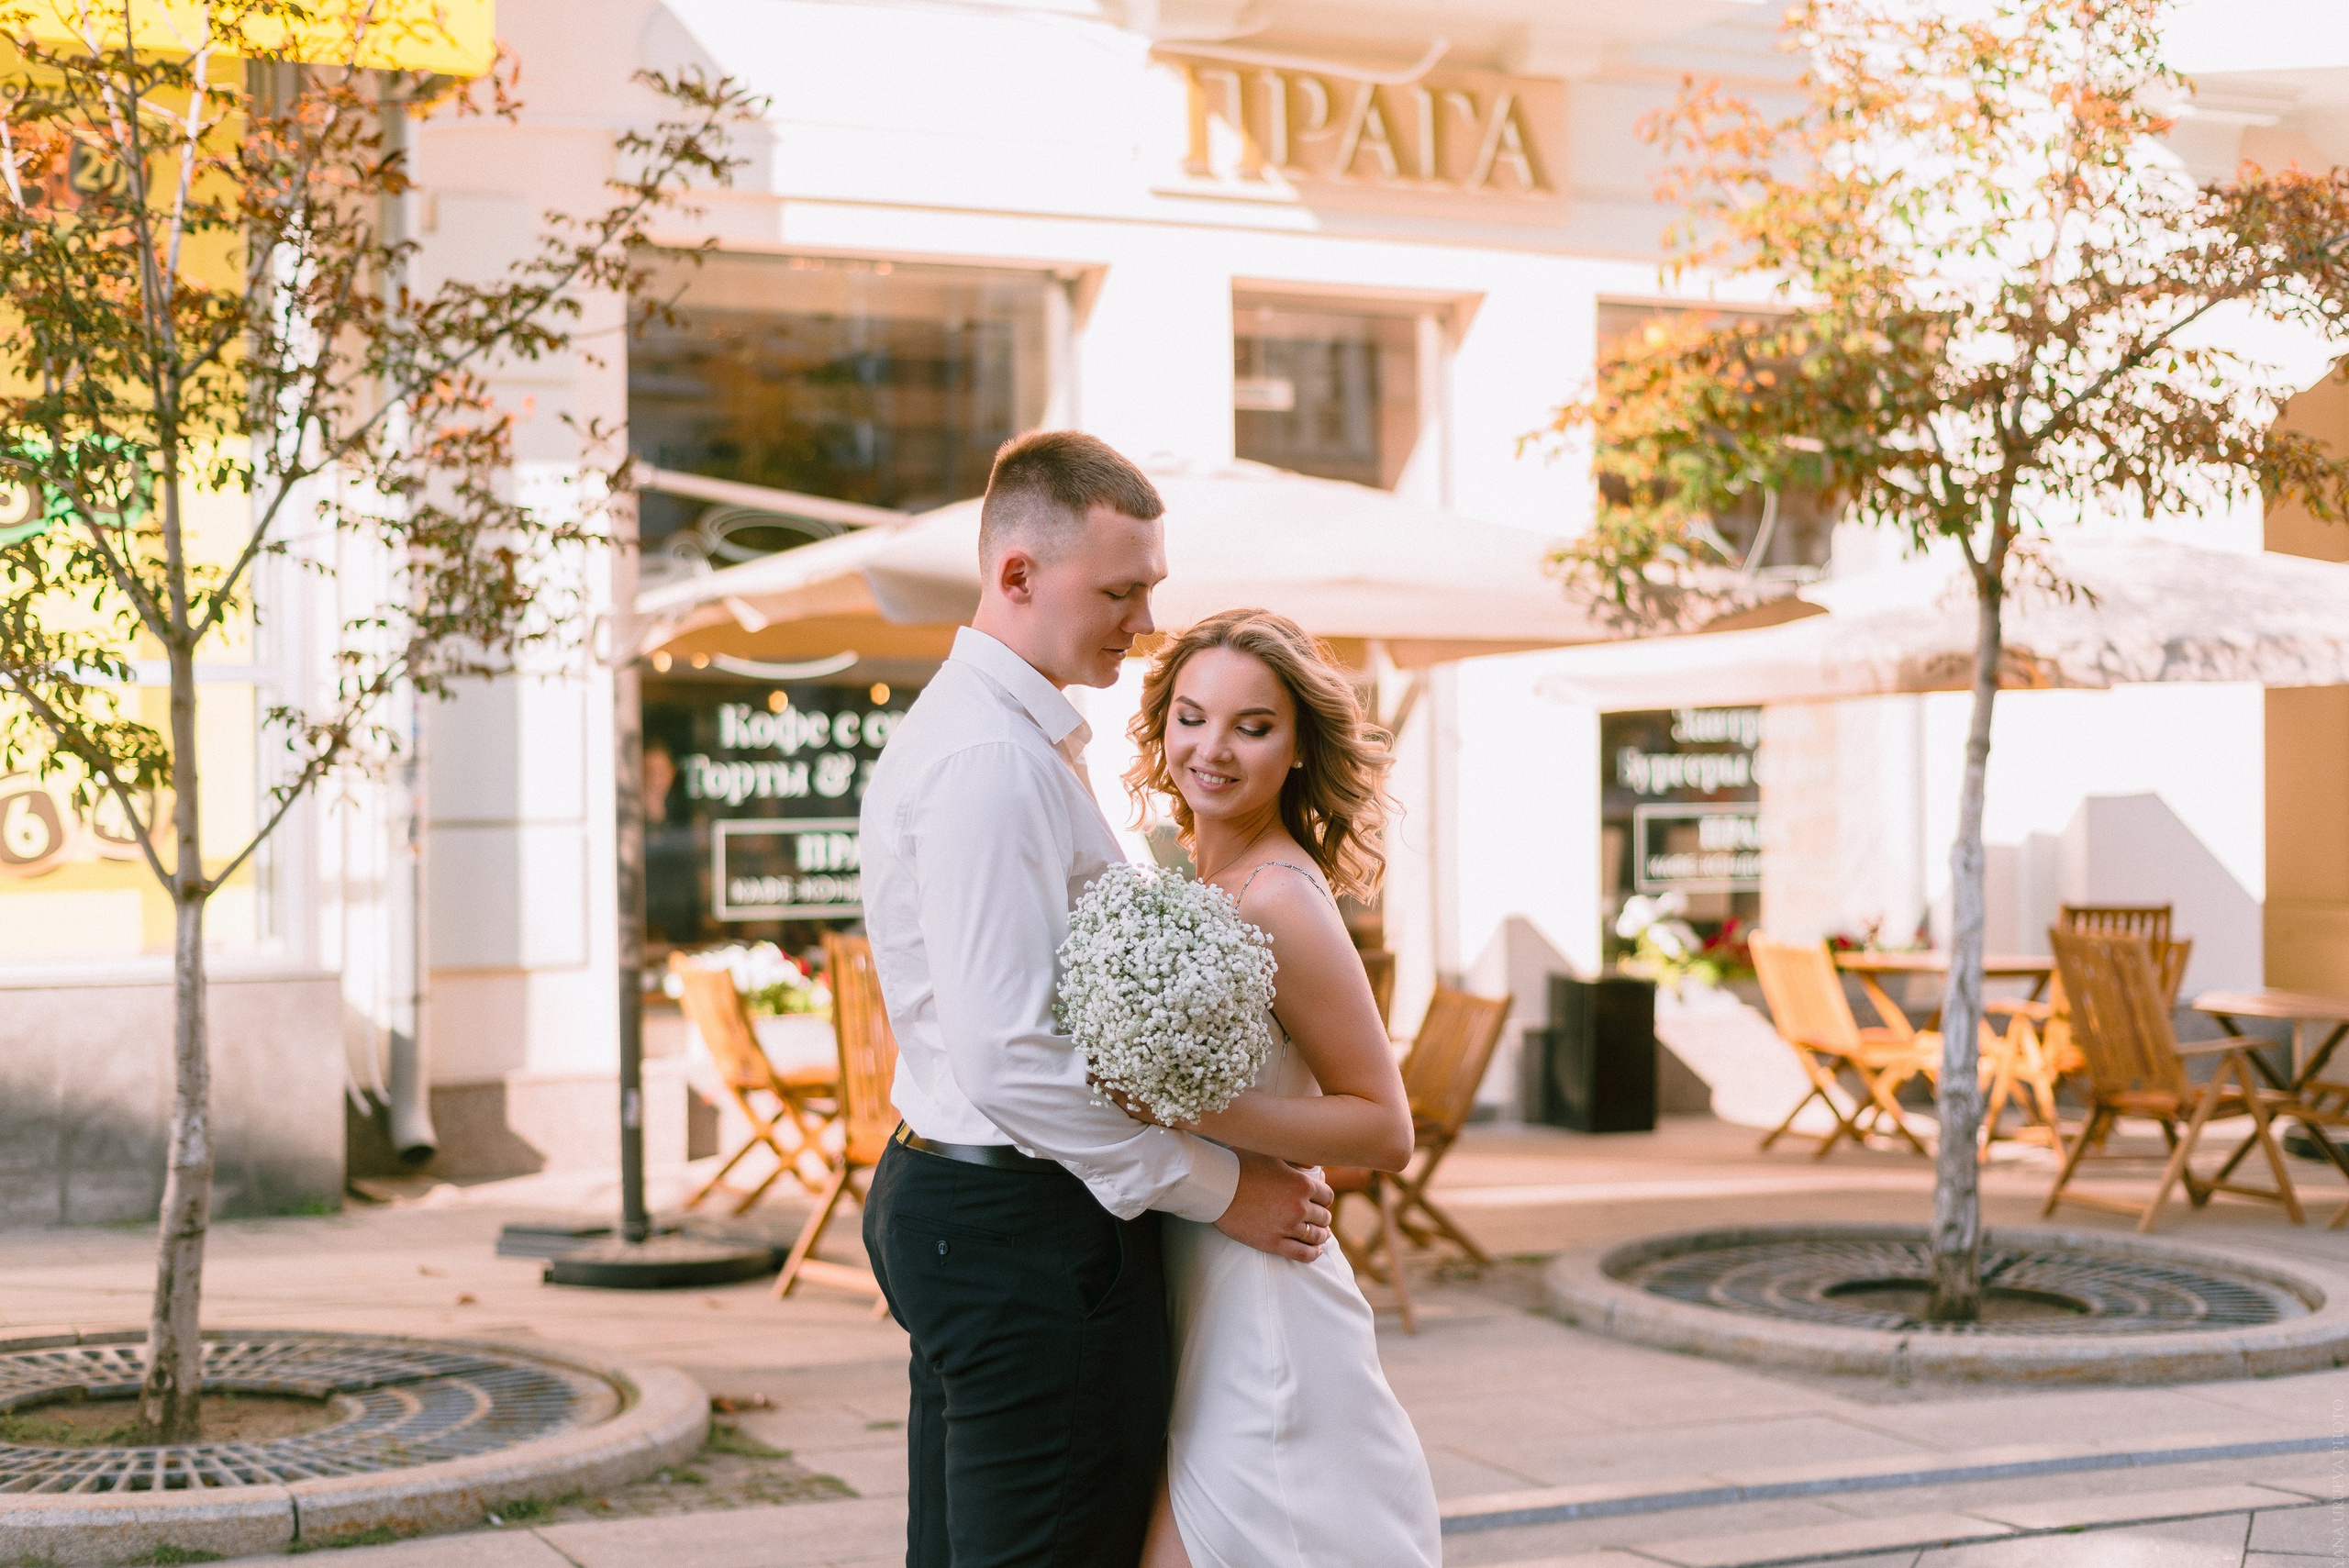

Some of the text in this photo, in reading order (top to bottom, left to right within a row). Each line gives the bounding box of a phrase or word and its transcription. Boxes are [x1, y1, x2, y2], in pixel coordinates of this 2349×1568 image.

[1181, 64, 1556, 195] ПРАГА
[719, 704, 830, 755] Кофе
[685, 753, 809, 806] Торты
[812, 751, 856, 797] &
